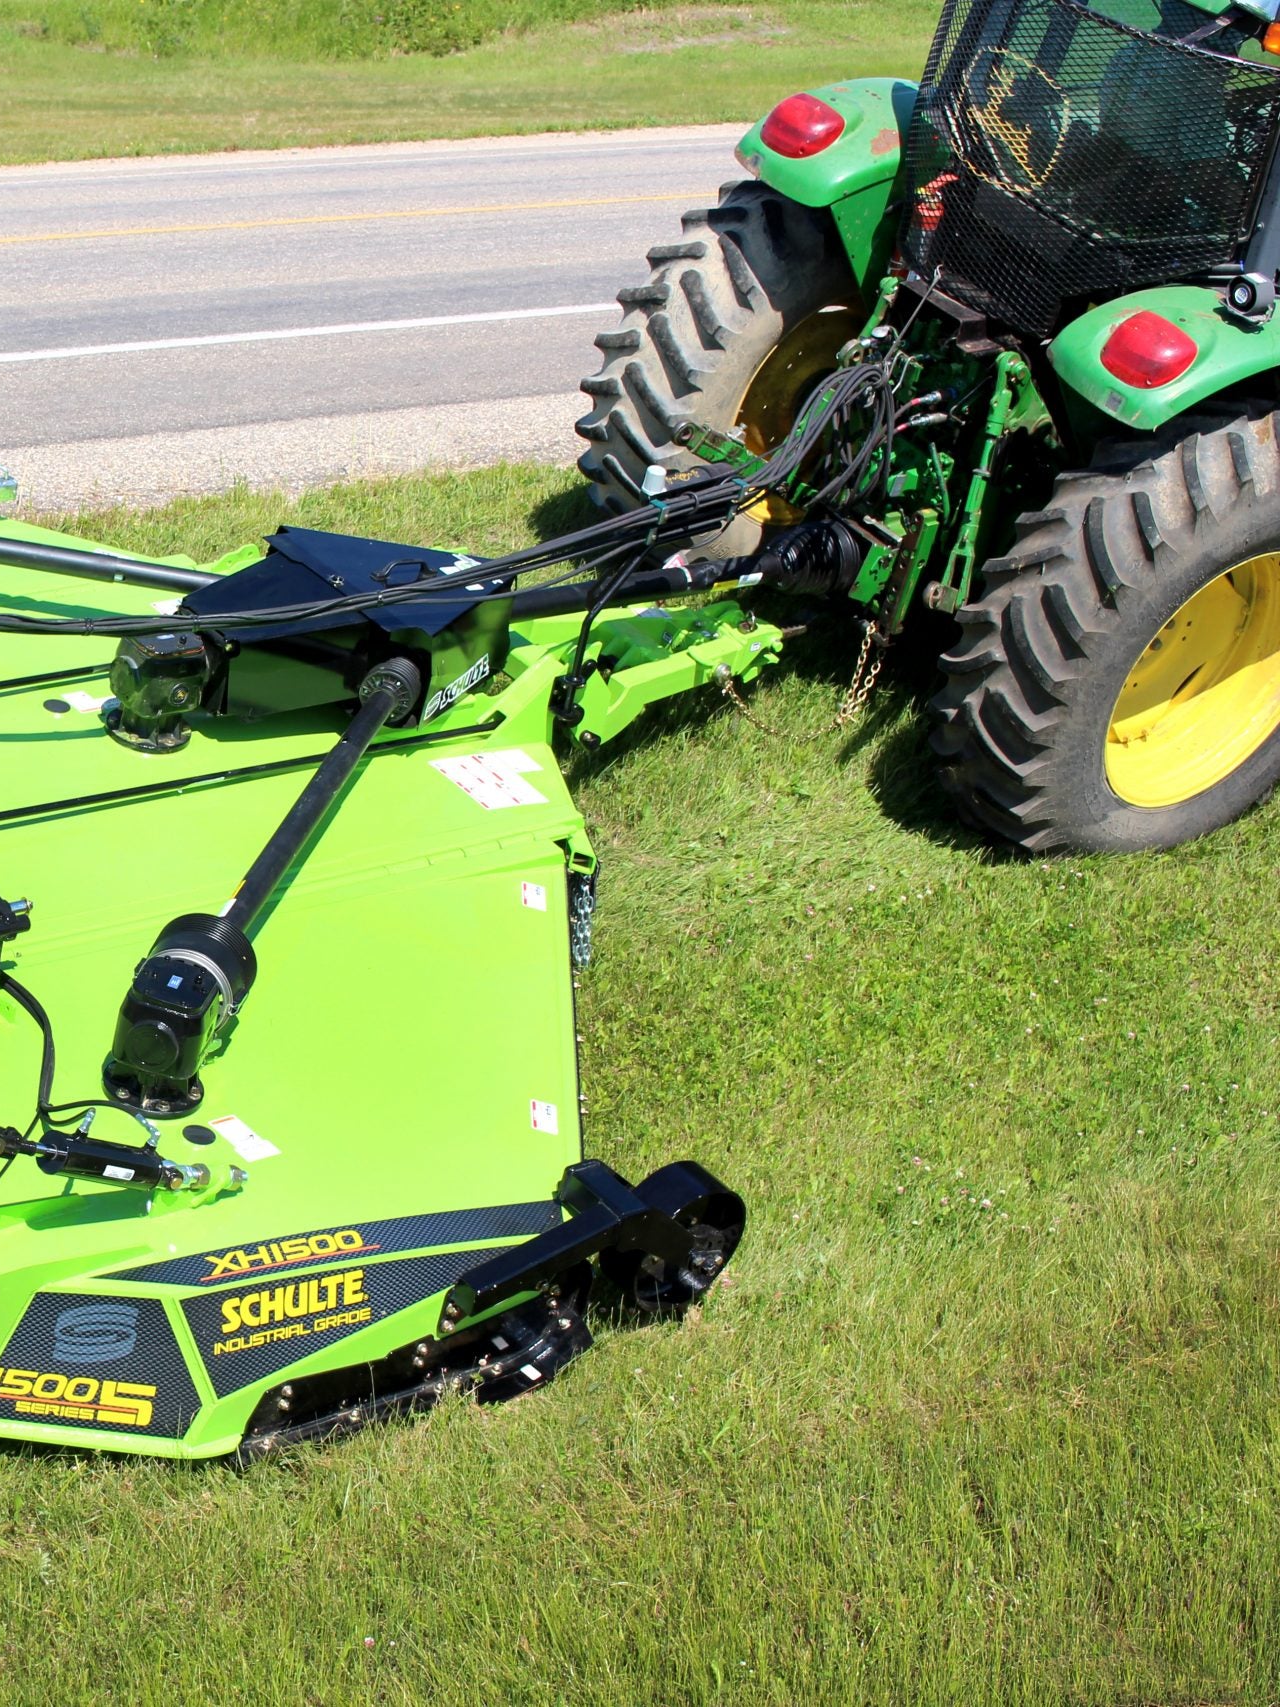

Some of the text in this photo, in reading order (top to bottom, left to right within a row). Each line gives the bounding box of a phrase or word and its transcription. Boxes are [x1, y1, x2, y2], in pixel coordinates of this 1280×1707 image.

[205, 1229, 364, 1276] XH1500
[221, 1270, 365, 1334] SCHULTE
[214, 1307, 372, 1356] INDUSTRIAL GRADE
[15, 1401, 96, 1420] SERIES
